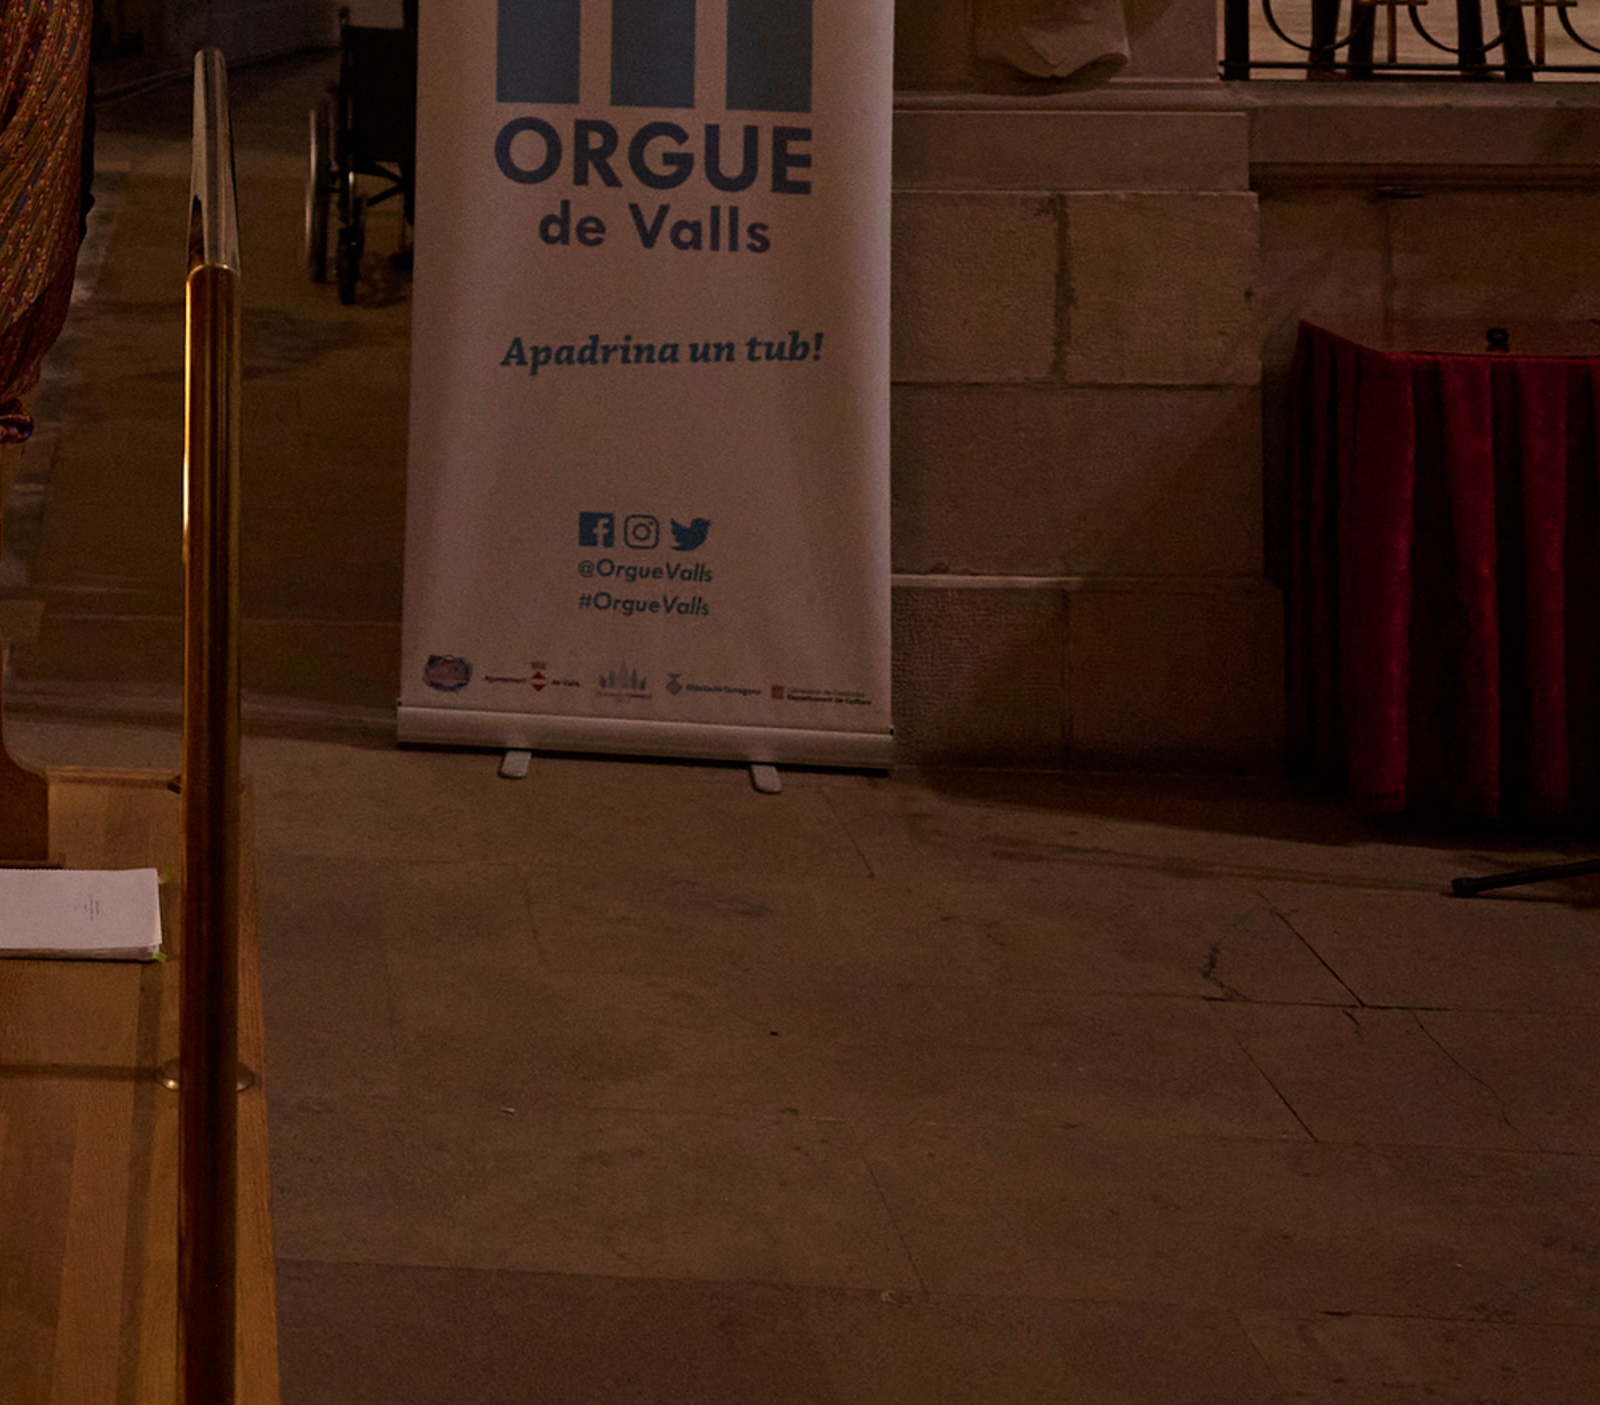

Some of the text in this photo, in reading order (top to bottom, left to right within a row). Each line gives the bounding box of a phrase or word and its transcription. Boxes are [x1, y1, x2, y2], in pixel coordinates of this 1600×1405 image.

[494, 117, 813, 196] ORGUE
[538, 199, 771, 254] de Valls
[501, 330, 824, 376] Apadrina un tub!
[577, 558, 713, 583] @OrgueValls
[577, 591, 710, 616] #OrgueValls
